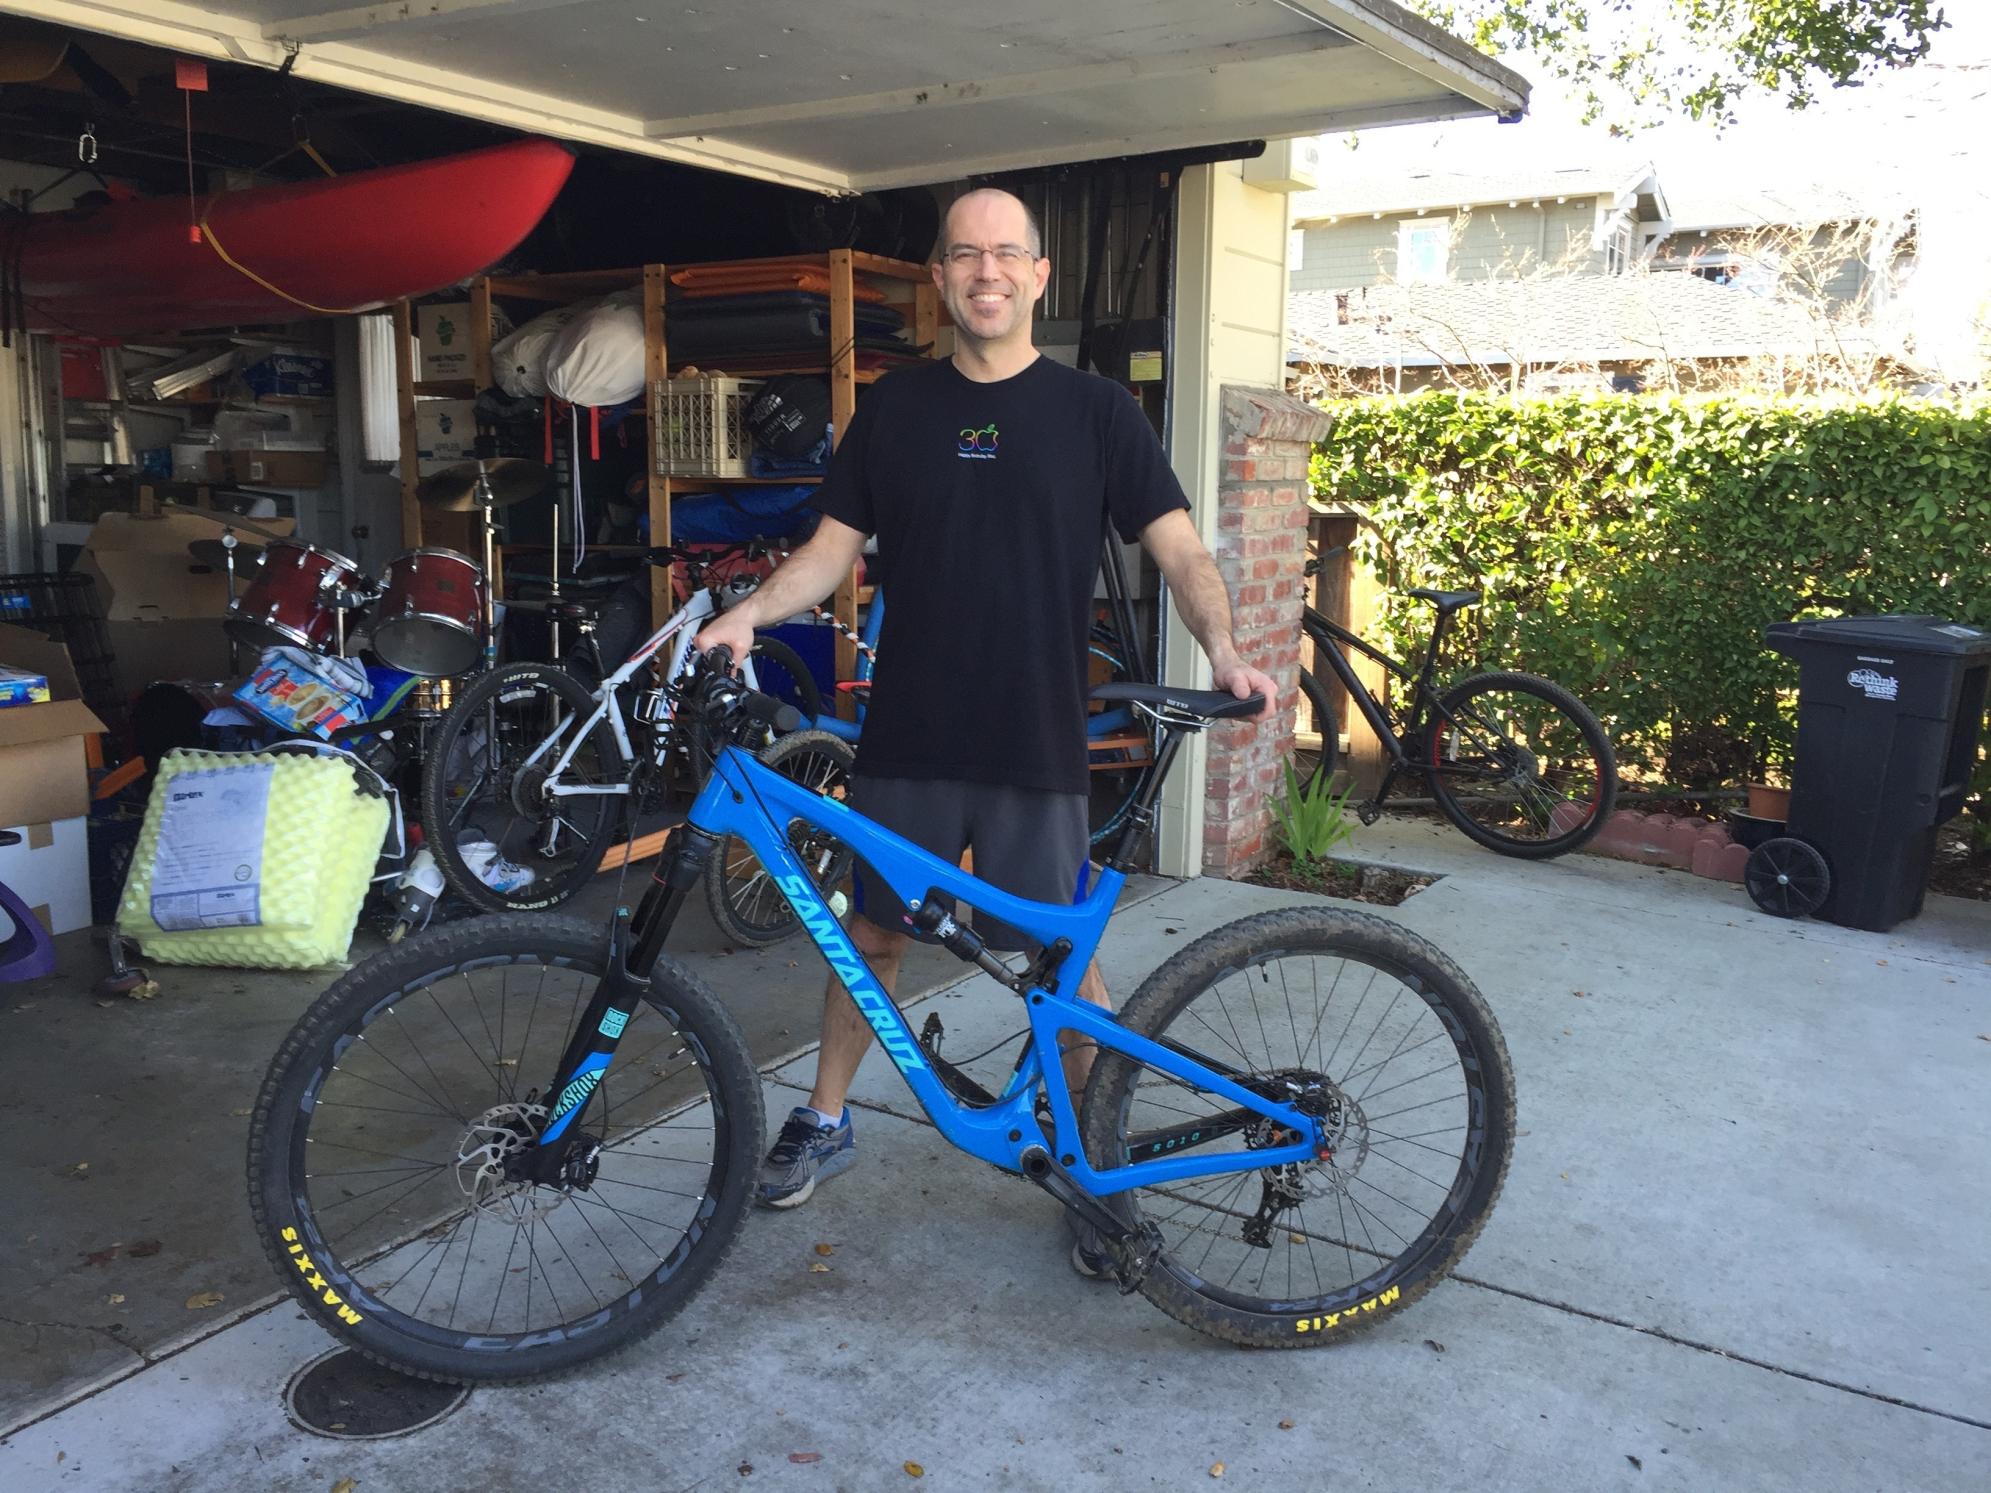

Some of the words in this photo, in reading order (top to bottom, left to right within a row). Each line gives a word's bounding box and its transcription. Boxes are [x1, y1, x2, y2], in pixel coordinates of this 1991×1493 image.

[1849, 672, 1899, 688] Rethink
[1864, 684, 1897, 696] waste
[775, 874, 866, 991] SANTA
[852, 990, 927, 1074] CRUZ
[1152, 1131, 1200, 1152] 5010
[281, 1226, 364, 1326] MAXXIS
